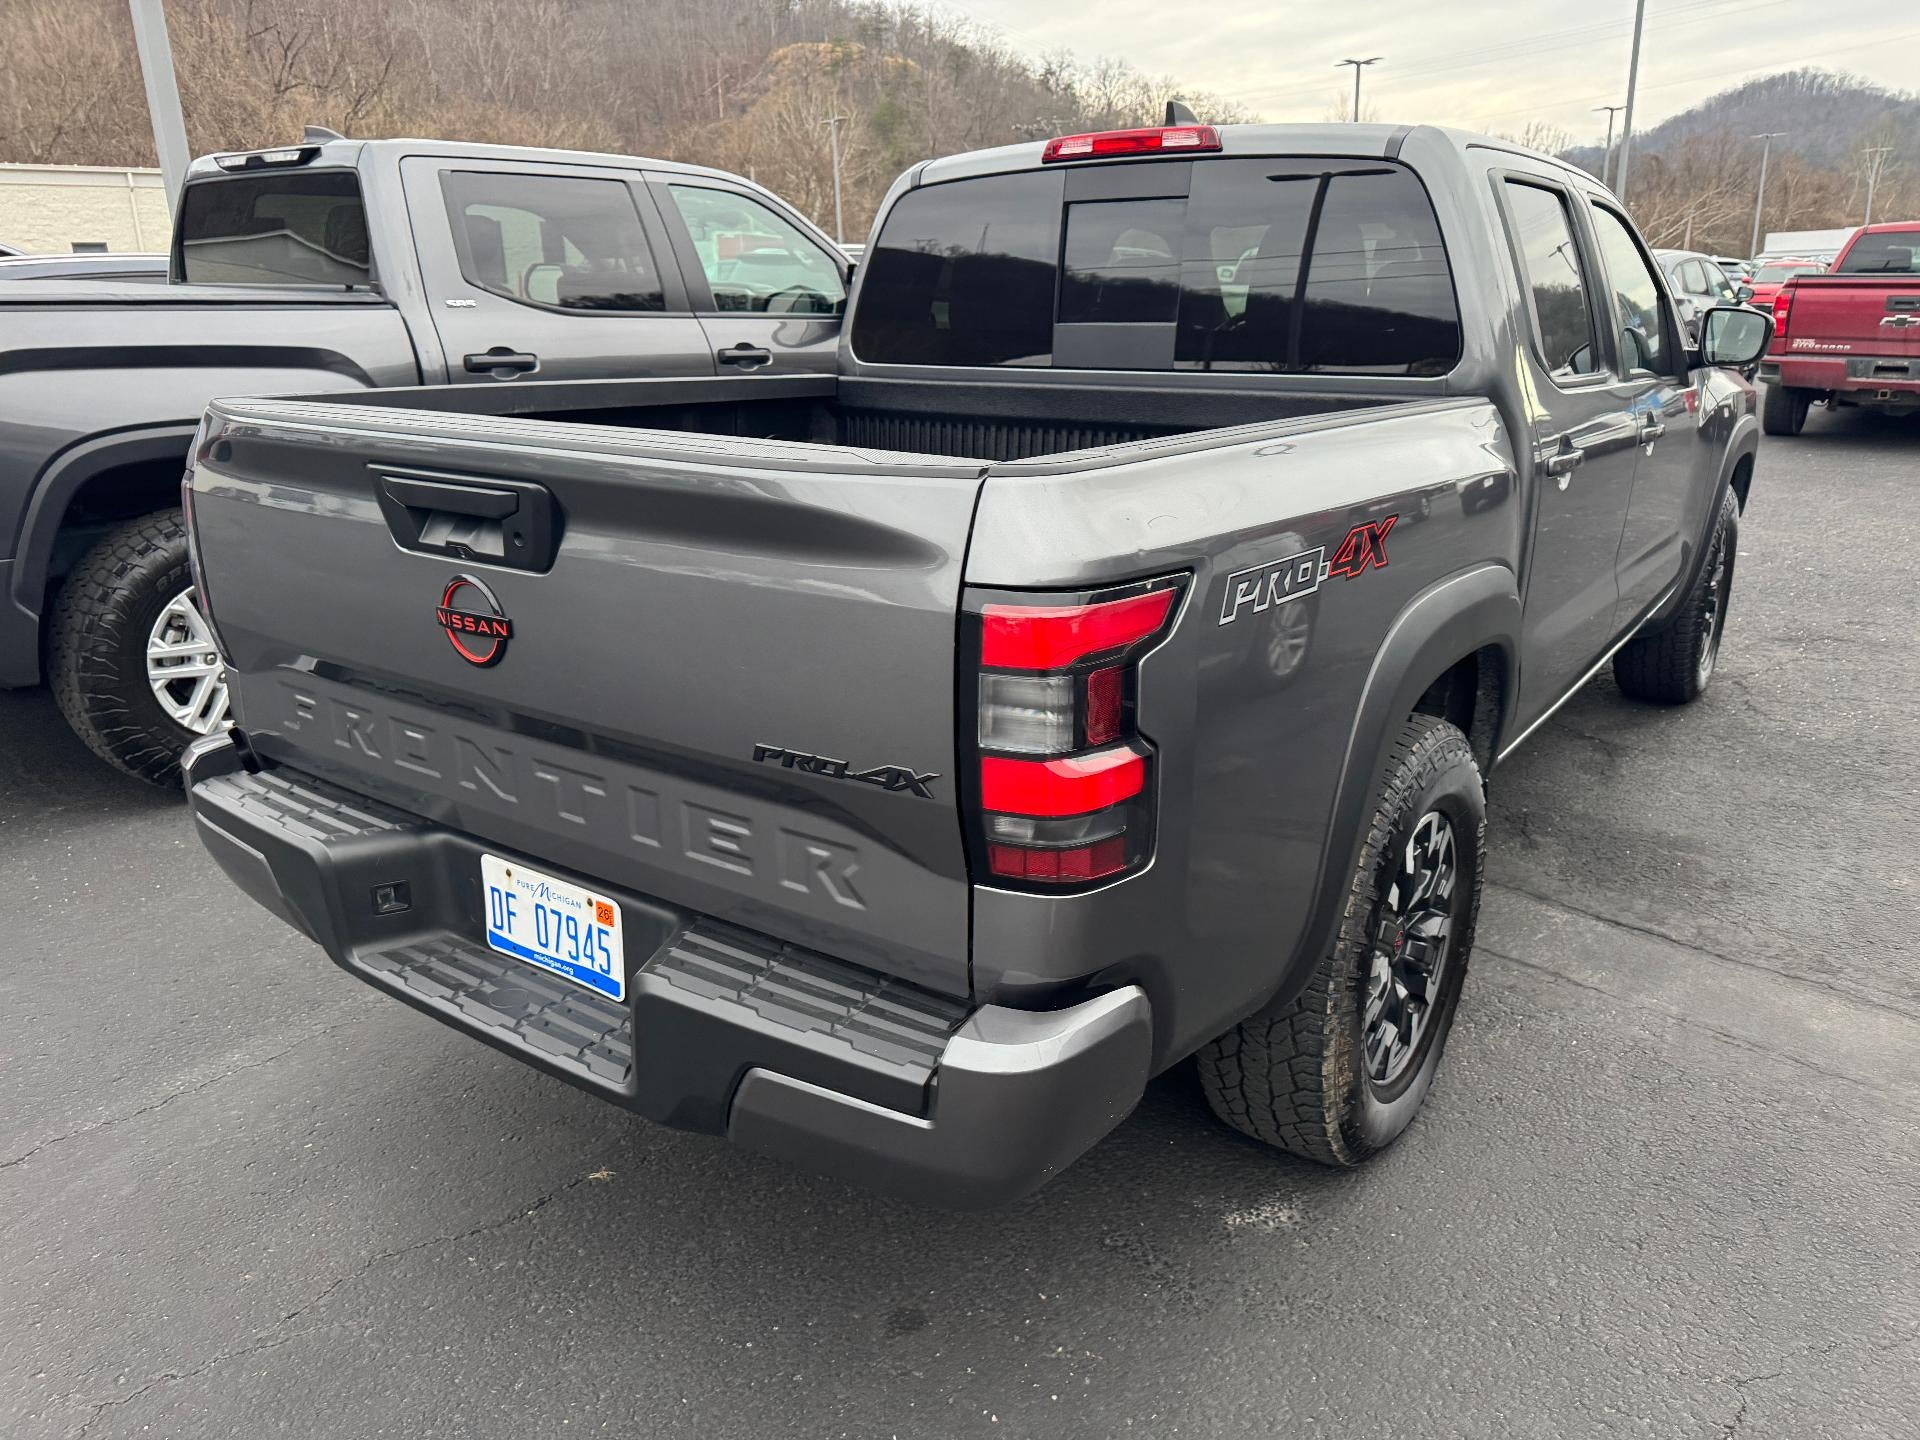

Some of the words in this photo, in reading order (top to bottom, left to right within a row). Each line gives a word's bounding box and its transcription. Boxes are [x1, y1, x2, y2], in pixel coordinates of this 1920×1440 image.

[437, 609, 508, 637] NISSAN
[752, 742, 943, 800] PRO-4X
[277, 681, 867, 910] FRONTIER
[516, 879, 535, 892] PURE
[532, 882, 582, 909] MICHIGAN
[598, 906, 609, 921] 26
[489, 885, 518, 935] DF
[535, 902, 611, 976] 07945
[533, 952, 574, 976] michigan.org
